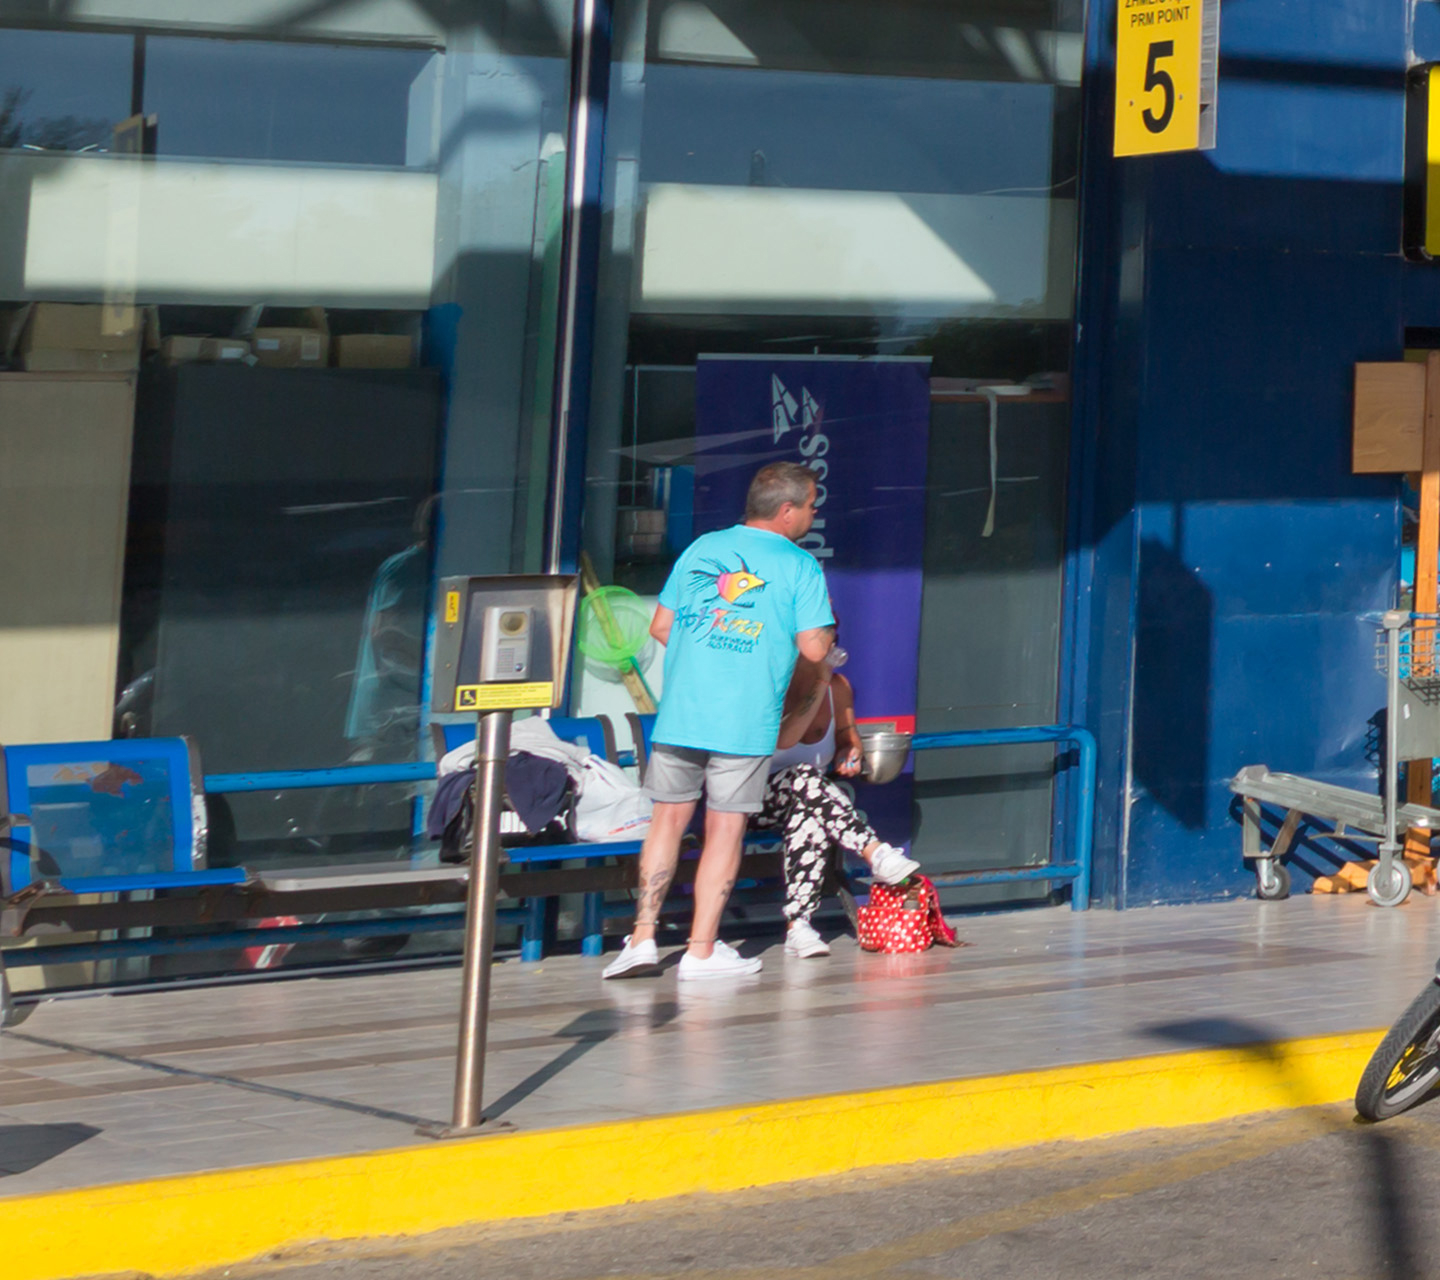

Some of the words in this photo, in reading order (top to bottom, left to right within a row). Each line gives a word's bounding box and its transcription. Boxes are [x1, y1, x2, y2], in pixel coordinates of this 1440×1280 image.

[1130, 11, 1155, 28] PRM
[1157, 5, 1190, 25] POINT
[1141, 40, 1174, 134] 5
